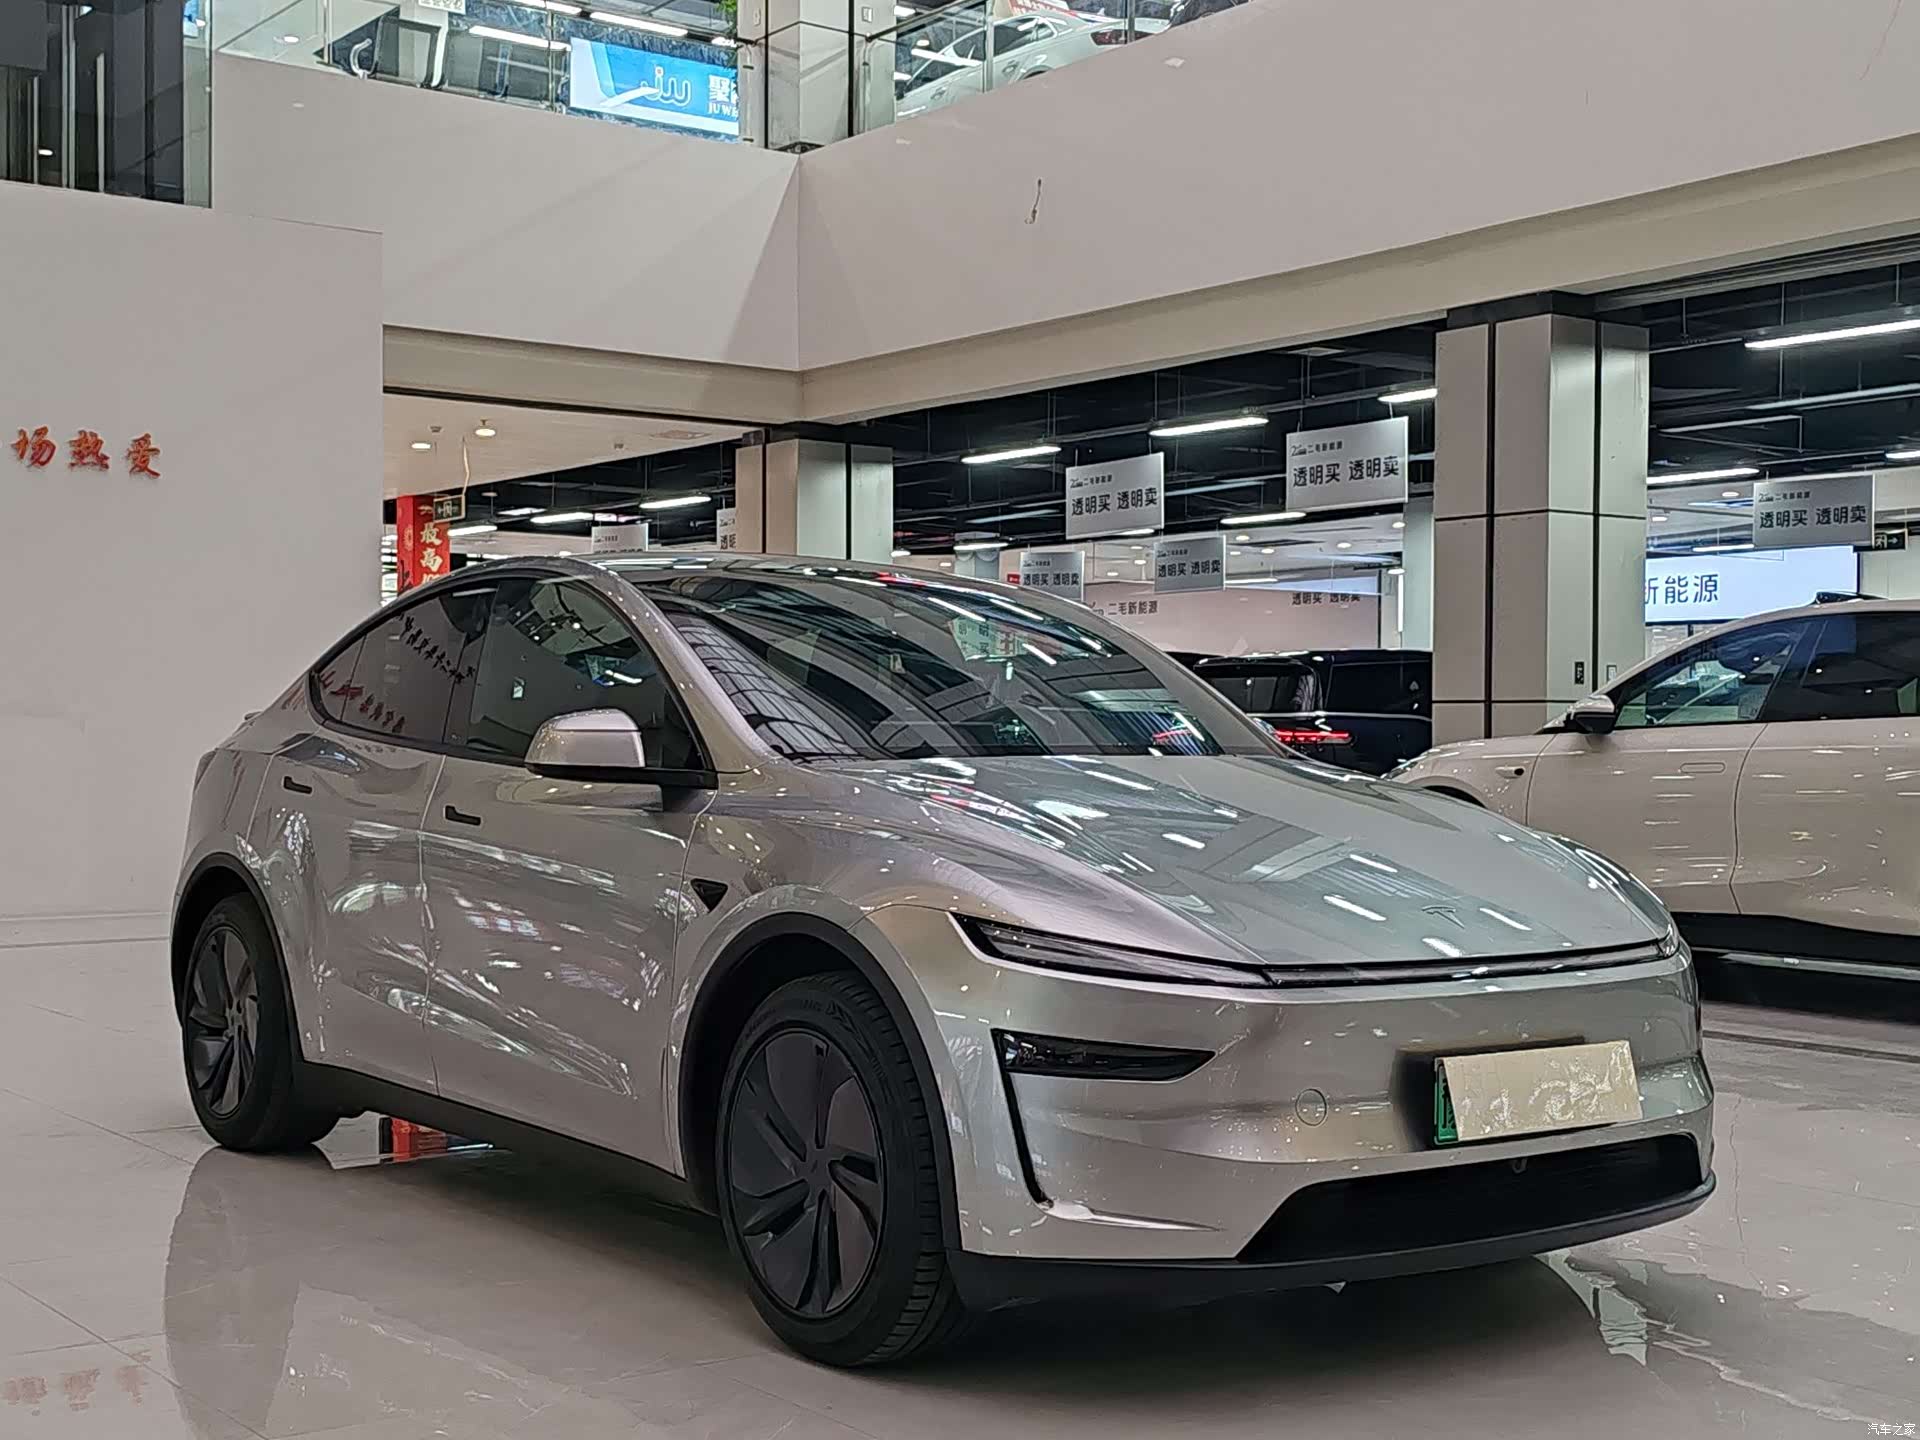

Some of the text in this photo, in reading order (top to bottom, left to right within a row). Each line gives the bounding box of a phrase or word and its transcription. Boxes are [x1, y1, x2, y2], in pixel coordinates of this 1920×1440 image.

[1293, 455, 1399, 487] 透明买 透明卖
[1071, 487, 1157, 516] 透明买 透明卖
[1759, 505, 1867, 528] 透明买 透明卖
